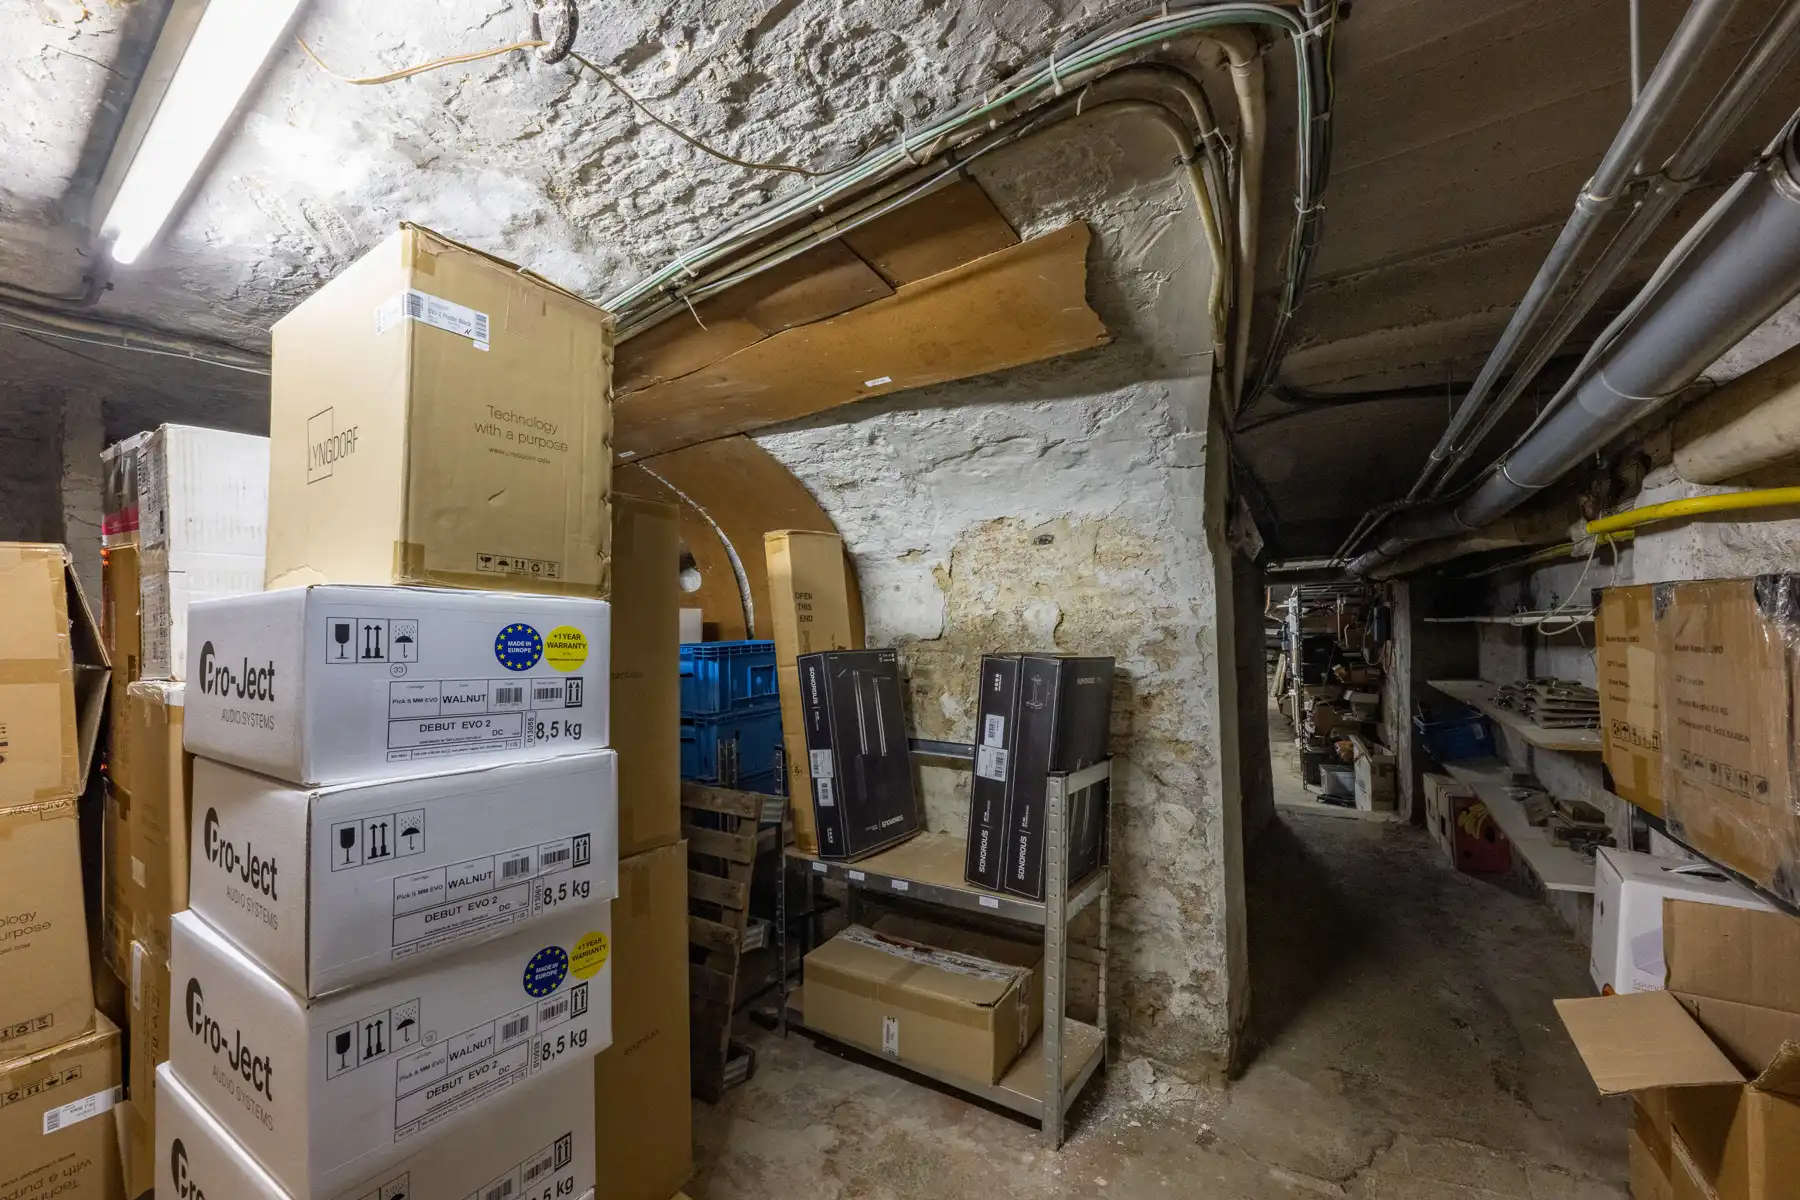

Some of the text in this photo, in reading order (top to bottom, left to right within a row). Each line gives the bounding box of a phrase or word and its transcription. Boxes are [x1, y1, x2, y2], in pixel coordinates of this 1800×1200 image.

[486, 404, 559, 435] Technology
[473, 421, 568, 452] with a purpose
[307, 425, 358, 471] LYNGDORF
[795, 592, 812, 600] OPEN
[797, 603, 812, 611] THIS
[199, 641, 275, 702] Pro-Ject
[809, 666, 818, 704] SONOROUS
[442, 694, 487, 704] WALNUT
[221, 709, 275, 730] AUDIO SYSTEMS
[419, 721, 456, 733] DEBUT
[462, 720, 483, 730] EVO
[492, 729, 504, 737] DC
[536, 719, 582, 743] 8,5 kg
[204, 807, 278, 901] Pro-Ject
[979, 830, 989, 873] SONOROUS
[1018, 836, 1028, 880] SONOROUS
[448, 871, 494, 890] WALNUT
[396, 891, 411, 901] Pick
[417, 888, 429, 896] MM
[430, 884, 444, 893] EVO
[543, 879, 590, 907] 8,5 kg
[226, 885, 278, 930] AUDIO SYSTEMS
[424, 906, 462, 924] DEBUT
[467, 899, 490, 912] EVO
[492, 896, 498, 905] 2
[499, 903, 511, 912] DC
[572, 943, 607, 962] WARRANTY
[586, 937, 602, 948] YEAR
[535, 964, 551, 973] MADE
[535, 969, 558, 980] EUROPE
[186, 978, 272, 1101] Pro-Ject
[449, 1036, 493, 1061] WALNUT
[542, 1028, 588, 1061] 8,5 kg
[399, 1072, 413, 1082] Pick
[419, 1065, 431, 1074] MM
[432, 1059, 445, 1068] EVO
[426, 1076, 463, 1100] DEBUT
[468, 1065, 490, 1081] EVO
[492, 1060, 498, 1069] 2
[498, 1065, 510, 1075] DC
[212, 1065, 273, 1131] AUDIO SYSTEMS
[48, 1173, 58, 1183] a
[63, 1159, 92, 1176] with
[30, 1180, 81, 1200] Tech
[557, 1176, 574, 1198] kg
